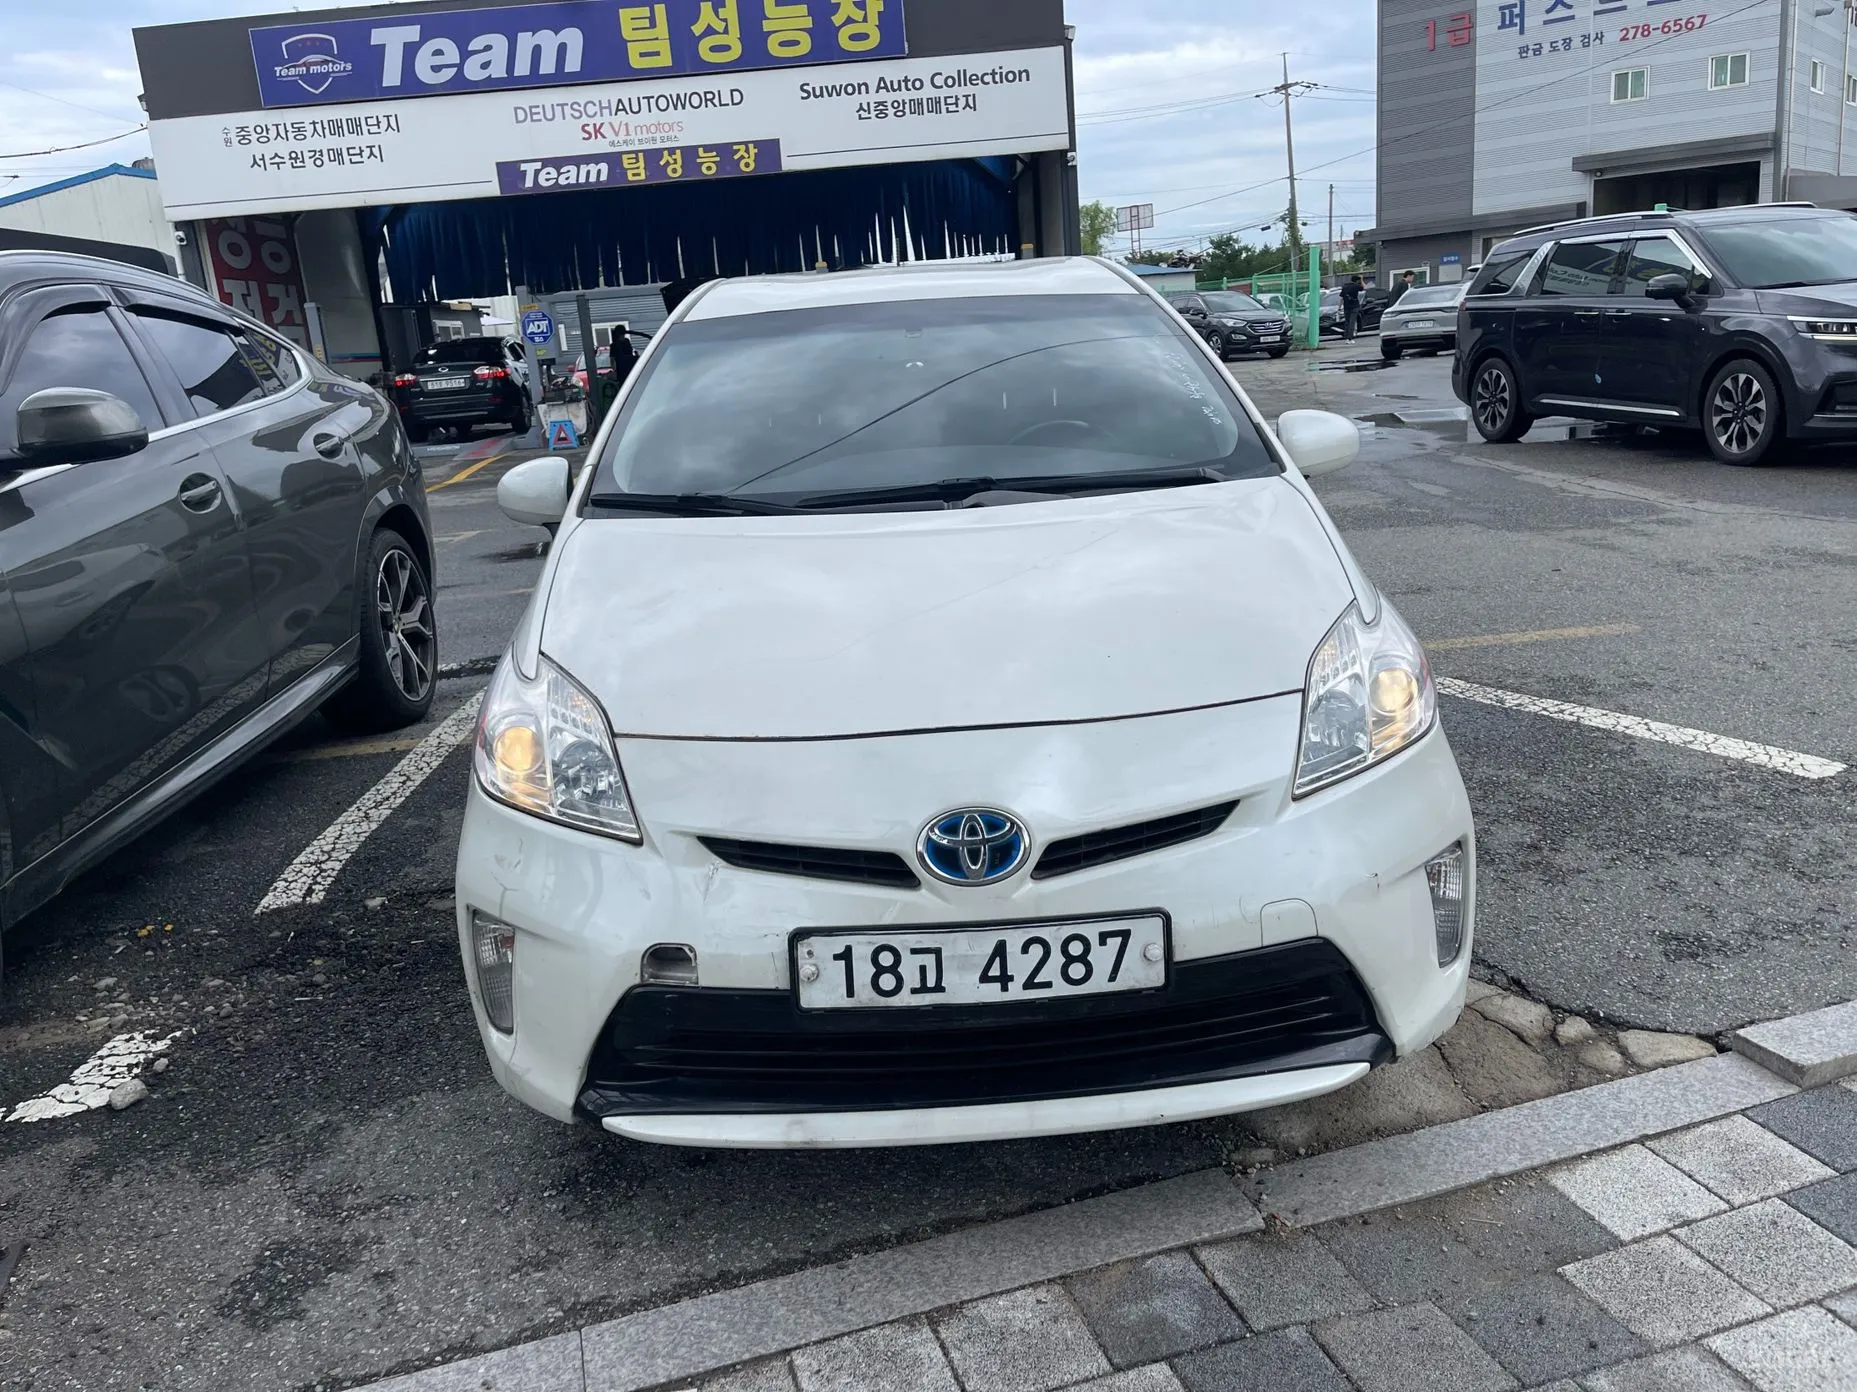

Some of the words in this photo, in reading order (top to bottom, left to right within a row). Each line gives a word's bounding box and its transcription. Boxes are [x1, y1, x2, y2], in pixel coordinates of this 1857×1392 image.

[1424, 11, 1473, 51] 1급
[1497, 0, 1682, 36] 퍼스
[1619, 14, 1709, 42] 278-6567
[370, 24, 584, 87] Team
[1518, 43, 1544, 60] 판금
[1549, 37, 1574, 53] 도장
[1579, 31, 1606, 49] 검사
[274, 65, 307, 78] Team
[309, 61, 353, 75] motors
[800, 82, 870, 100] Suwon
[875, 76, 925, 95] Auto
[930, 66, 1031, 90] Collection
[855, 93, 978, 121] 신중앙매매단지
[222, 126, 233, 148] 수원
[235, 113, 401, 146] 중앙자동차매매단지
[580, 122, 607, 141] SK
[633, 120, 684, 136] motors
[608, 138, 636, 149] 에스케이
[637, 136, 658, 146] 브이원
[659, 134, 680, 144] 모터스
[250, 144, 385, 172] 서수원경매단지
[520, 161, 609, 188] Team
[526, 319, 549, 335] ADT
[832, 944, 946, 998] 18고
[978, 928, 1132, 992] 4287
